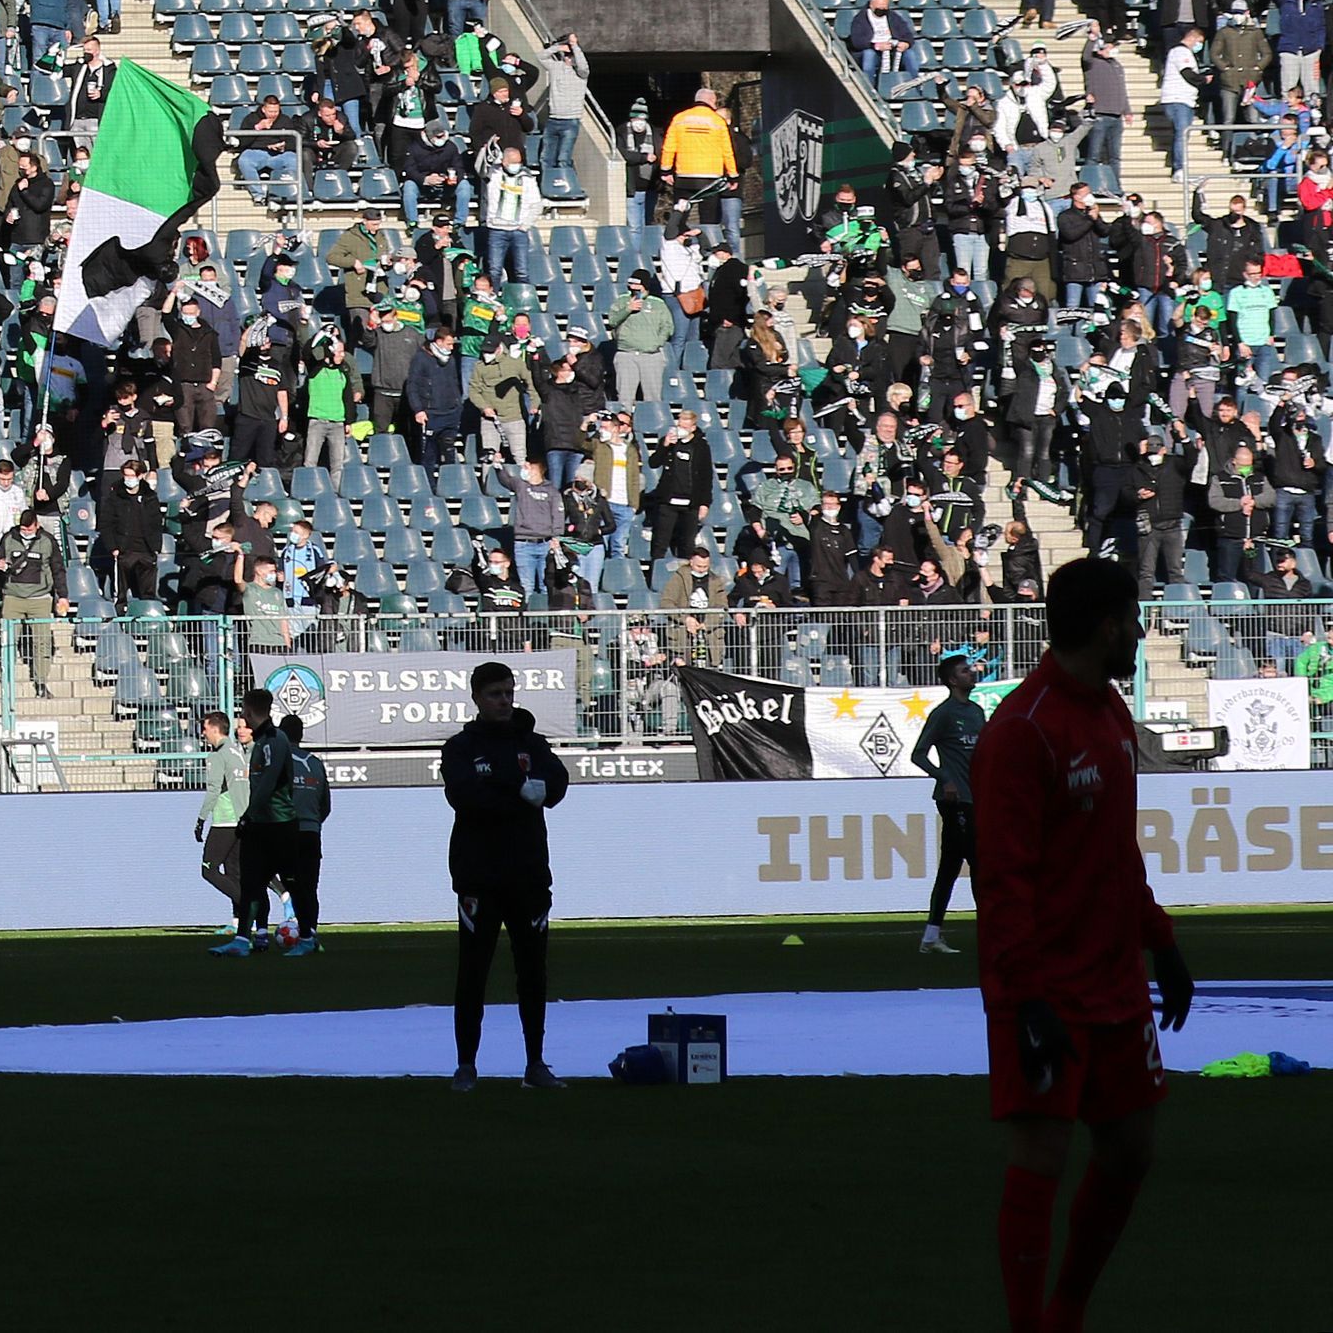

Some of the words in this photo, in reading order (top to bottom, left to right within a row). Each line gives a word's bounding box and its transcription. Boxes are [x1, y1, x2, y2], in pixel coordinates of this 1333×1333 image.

[329, 669, 566, 692] FELSENER
[379, 701, 483, 724] FOHL
[696, 689, 795, 737] Bökel
[576, 755, 665, 778] flatex
[758, 812, 971, 883] IHN
[1137, 786, 1333, 874] RÄSE
